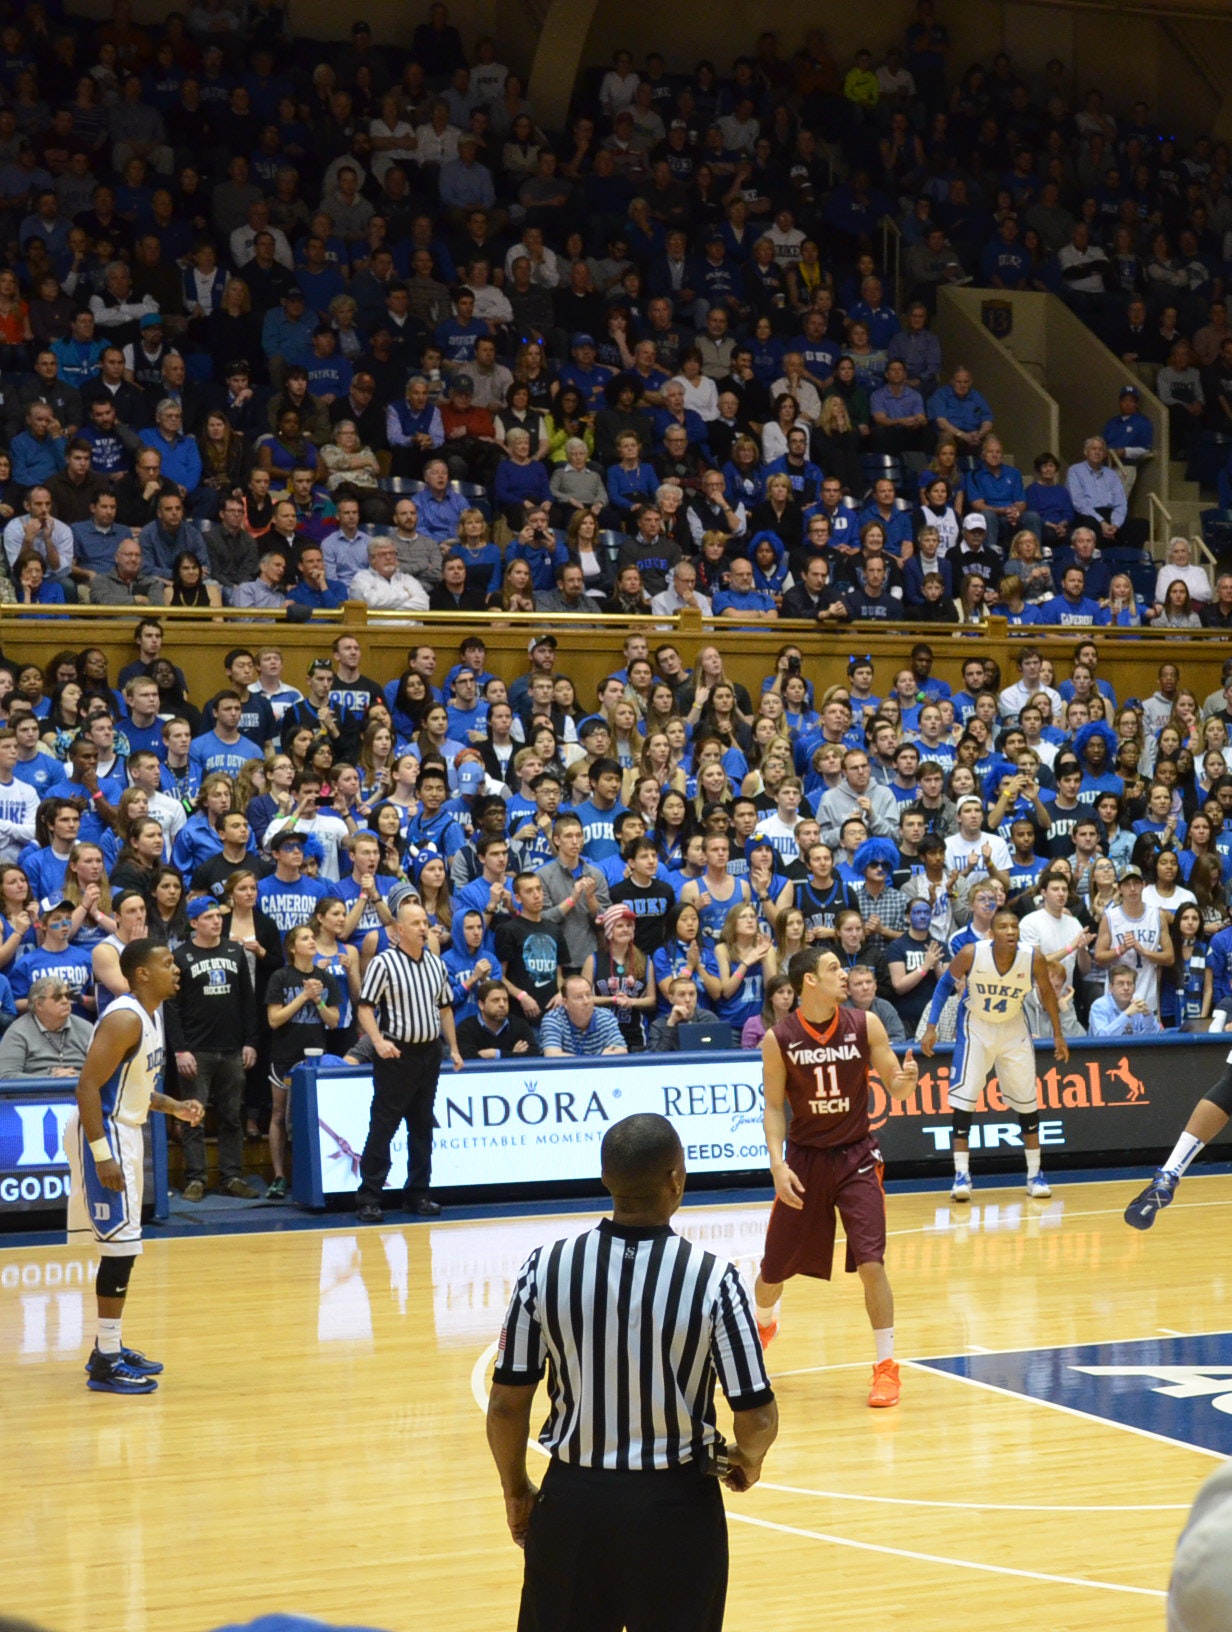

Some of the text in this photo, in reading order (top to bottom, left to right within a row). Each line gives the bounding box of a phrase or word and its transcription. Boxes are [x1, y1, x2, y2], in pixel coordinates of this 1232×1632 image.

[583, 821, 616, 845] DUK
[770, 836, 799, 856] DUK
[261, 894, 317, 915] CAMERON
[191, 957, 238, 979] BLUE DEVILS
[529, 958, 557, 973] DUKE
[203, 984, 232, 996] HOCKEY
[975, 983, 1023, 999] DUKE
[983, 998, 1007, 1014] 14
[786, 1044, 862, 1066] VIRGINIA
[813, 1065, 841, 1098] 11
[433, 1083, 610, 1130] NDORA
[808, 1097, 850, 1115] TECH
[922, 1120, 1066, 1151] TIRE
[684, 1141, 770, 1161] EEDS.com
